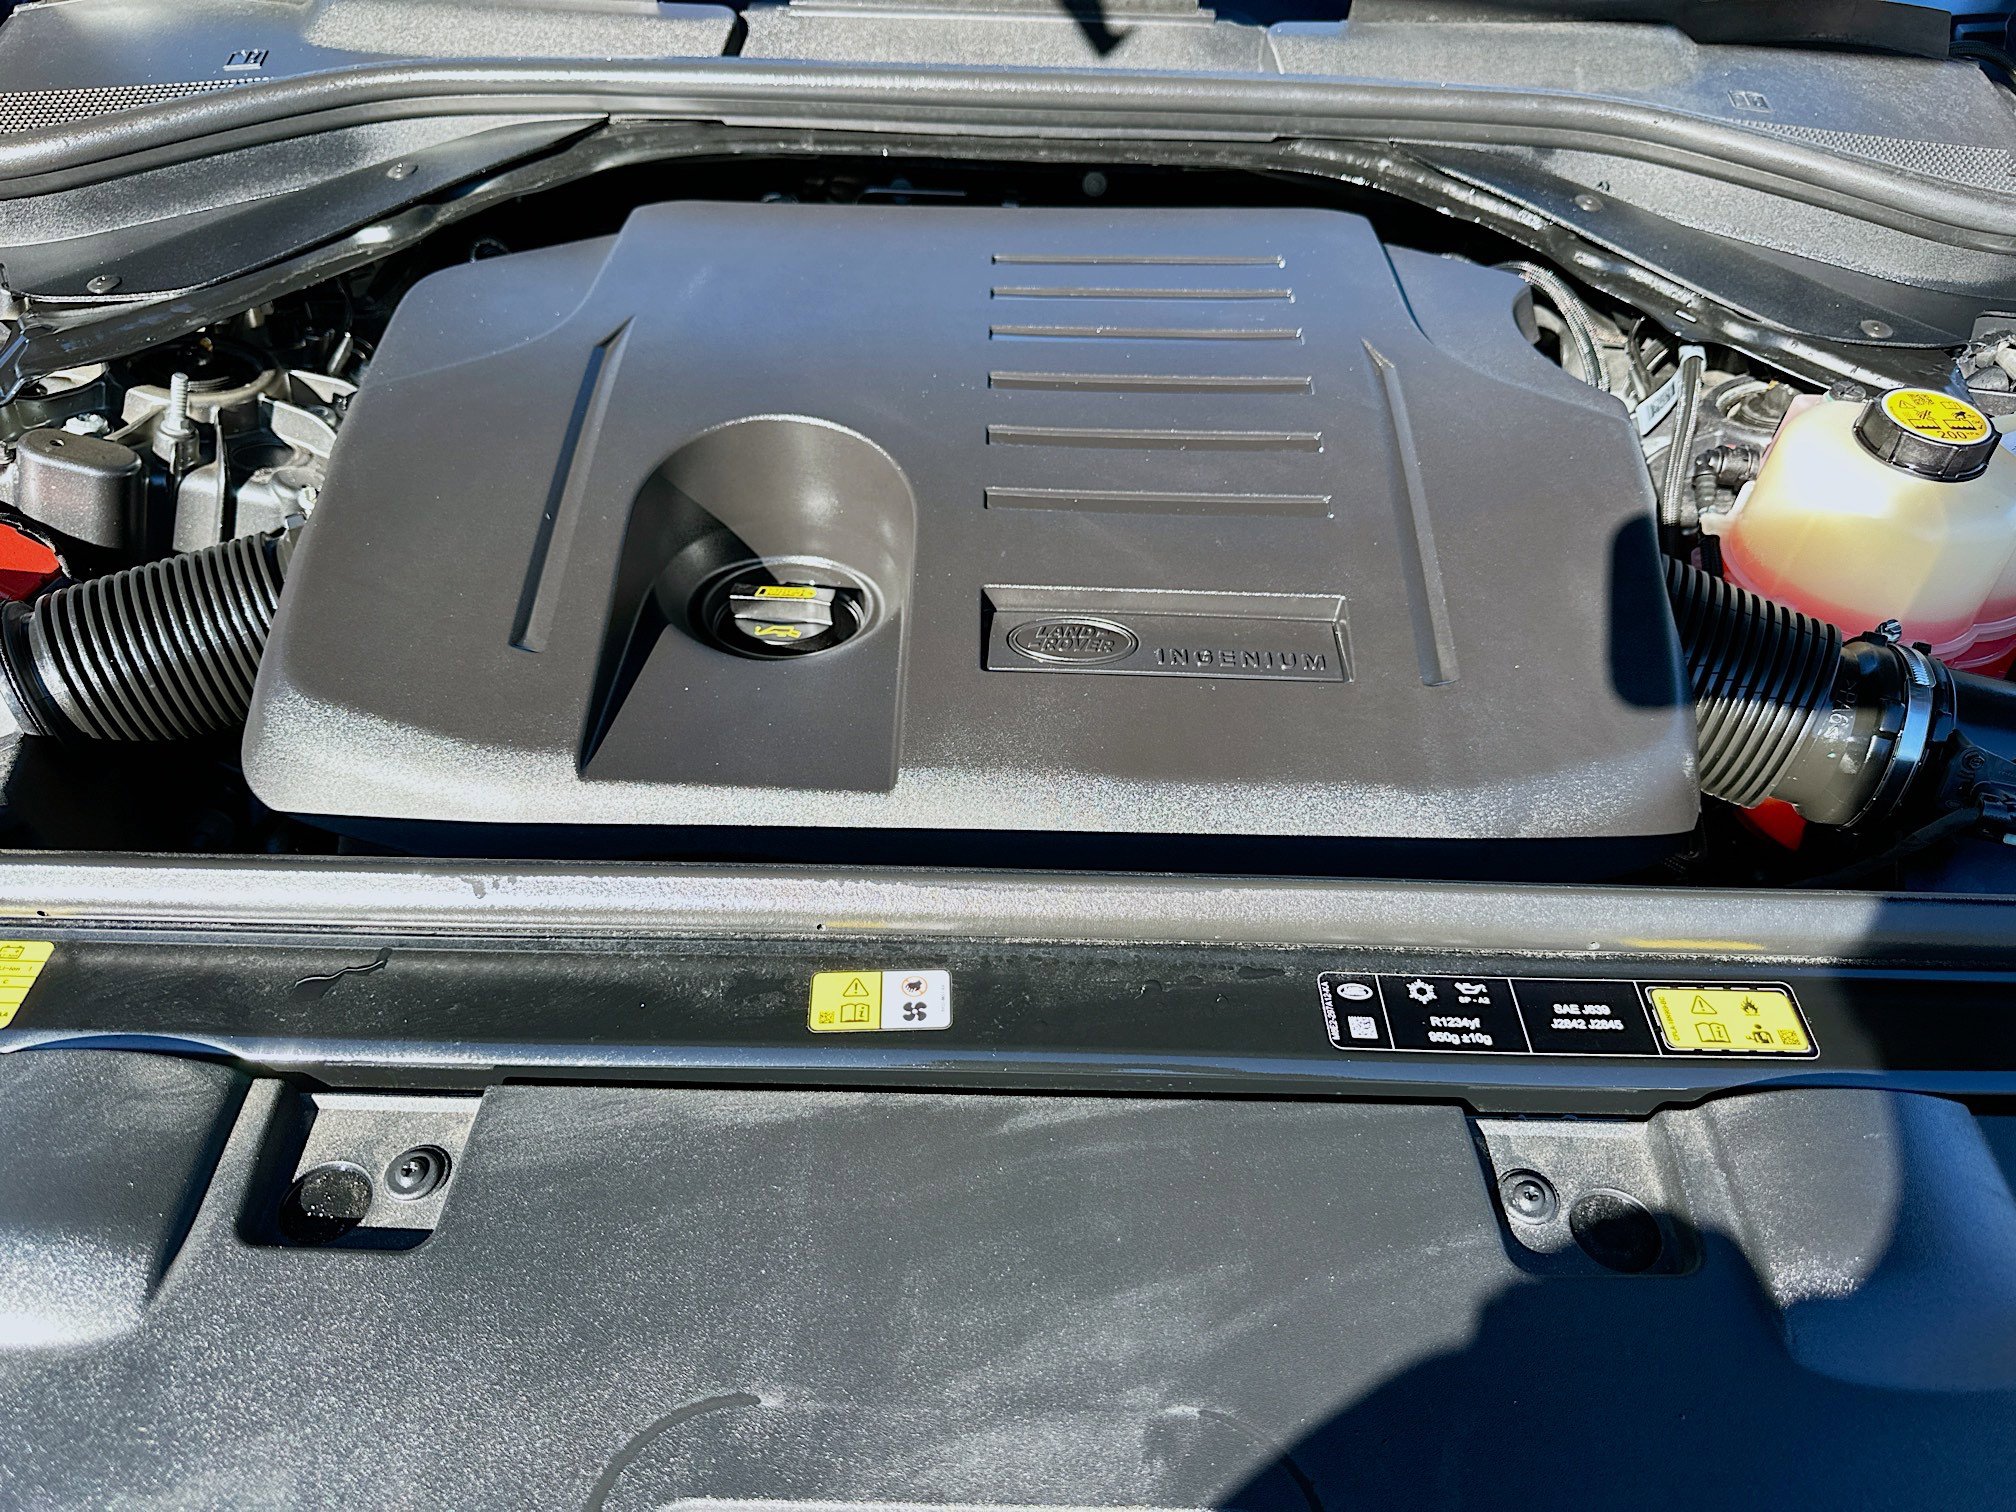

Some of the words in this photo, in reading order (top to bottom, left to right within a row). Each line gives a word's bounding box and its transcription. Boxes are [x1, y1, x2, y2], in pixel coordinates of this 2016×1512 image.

[1937, 430, 1968, 439] 200
[1035, 626, 1097, 639] LAND
[1040, 637, 1115, 653] ROVER
[1153, 648, 1326, 671] INGENIUM
[1552, 1003, 1581, 1015] SAE
[1429, 1015, 1481, 1030] R1234yf
